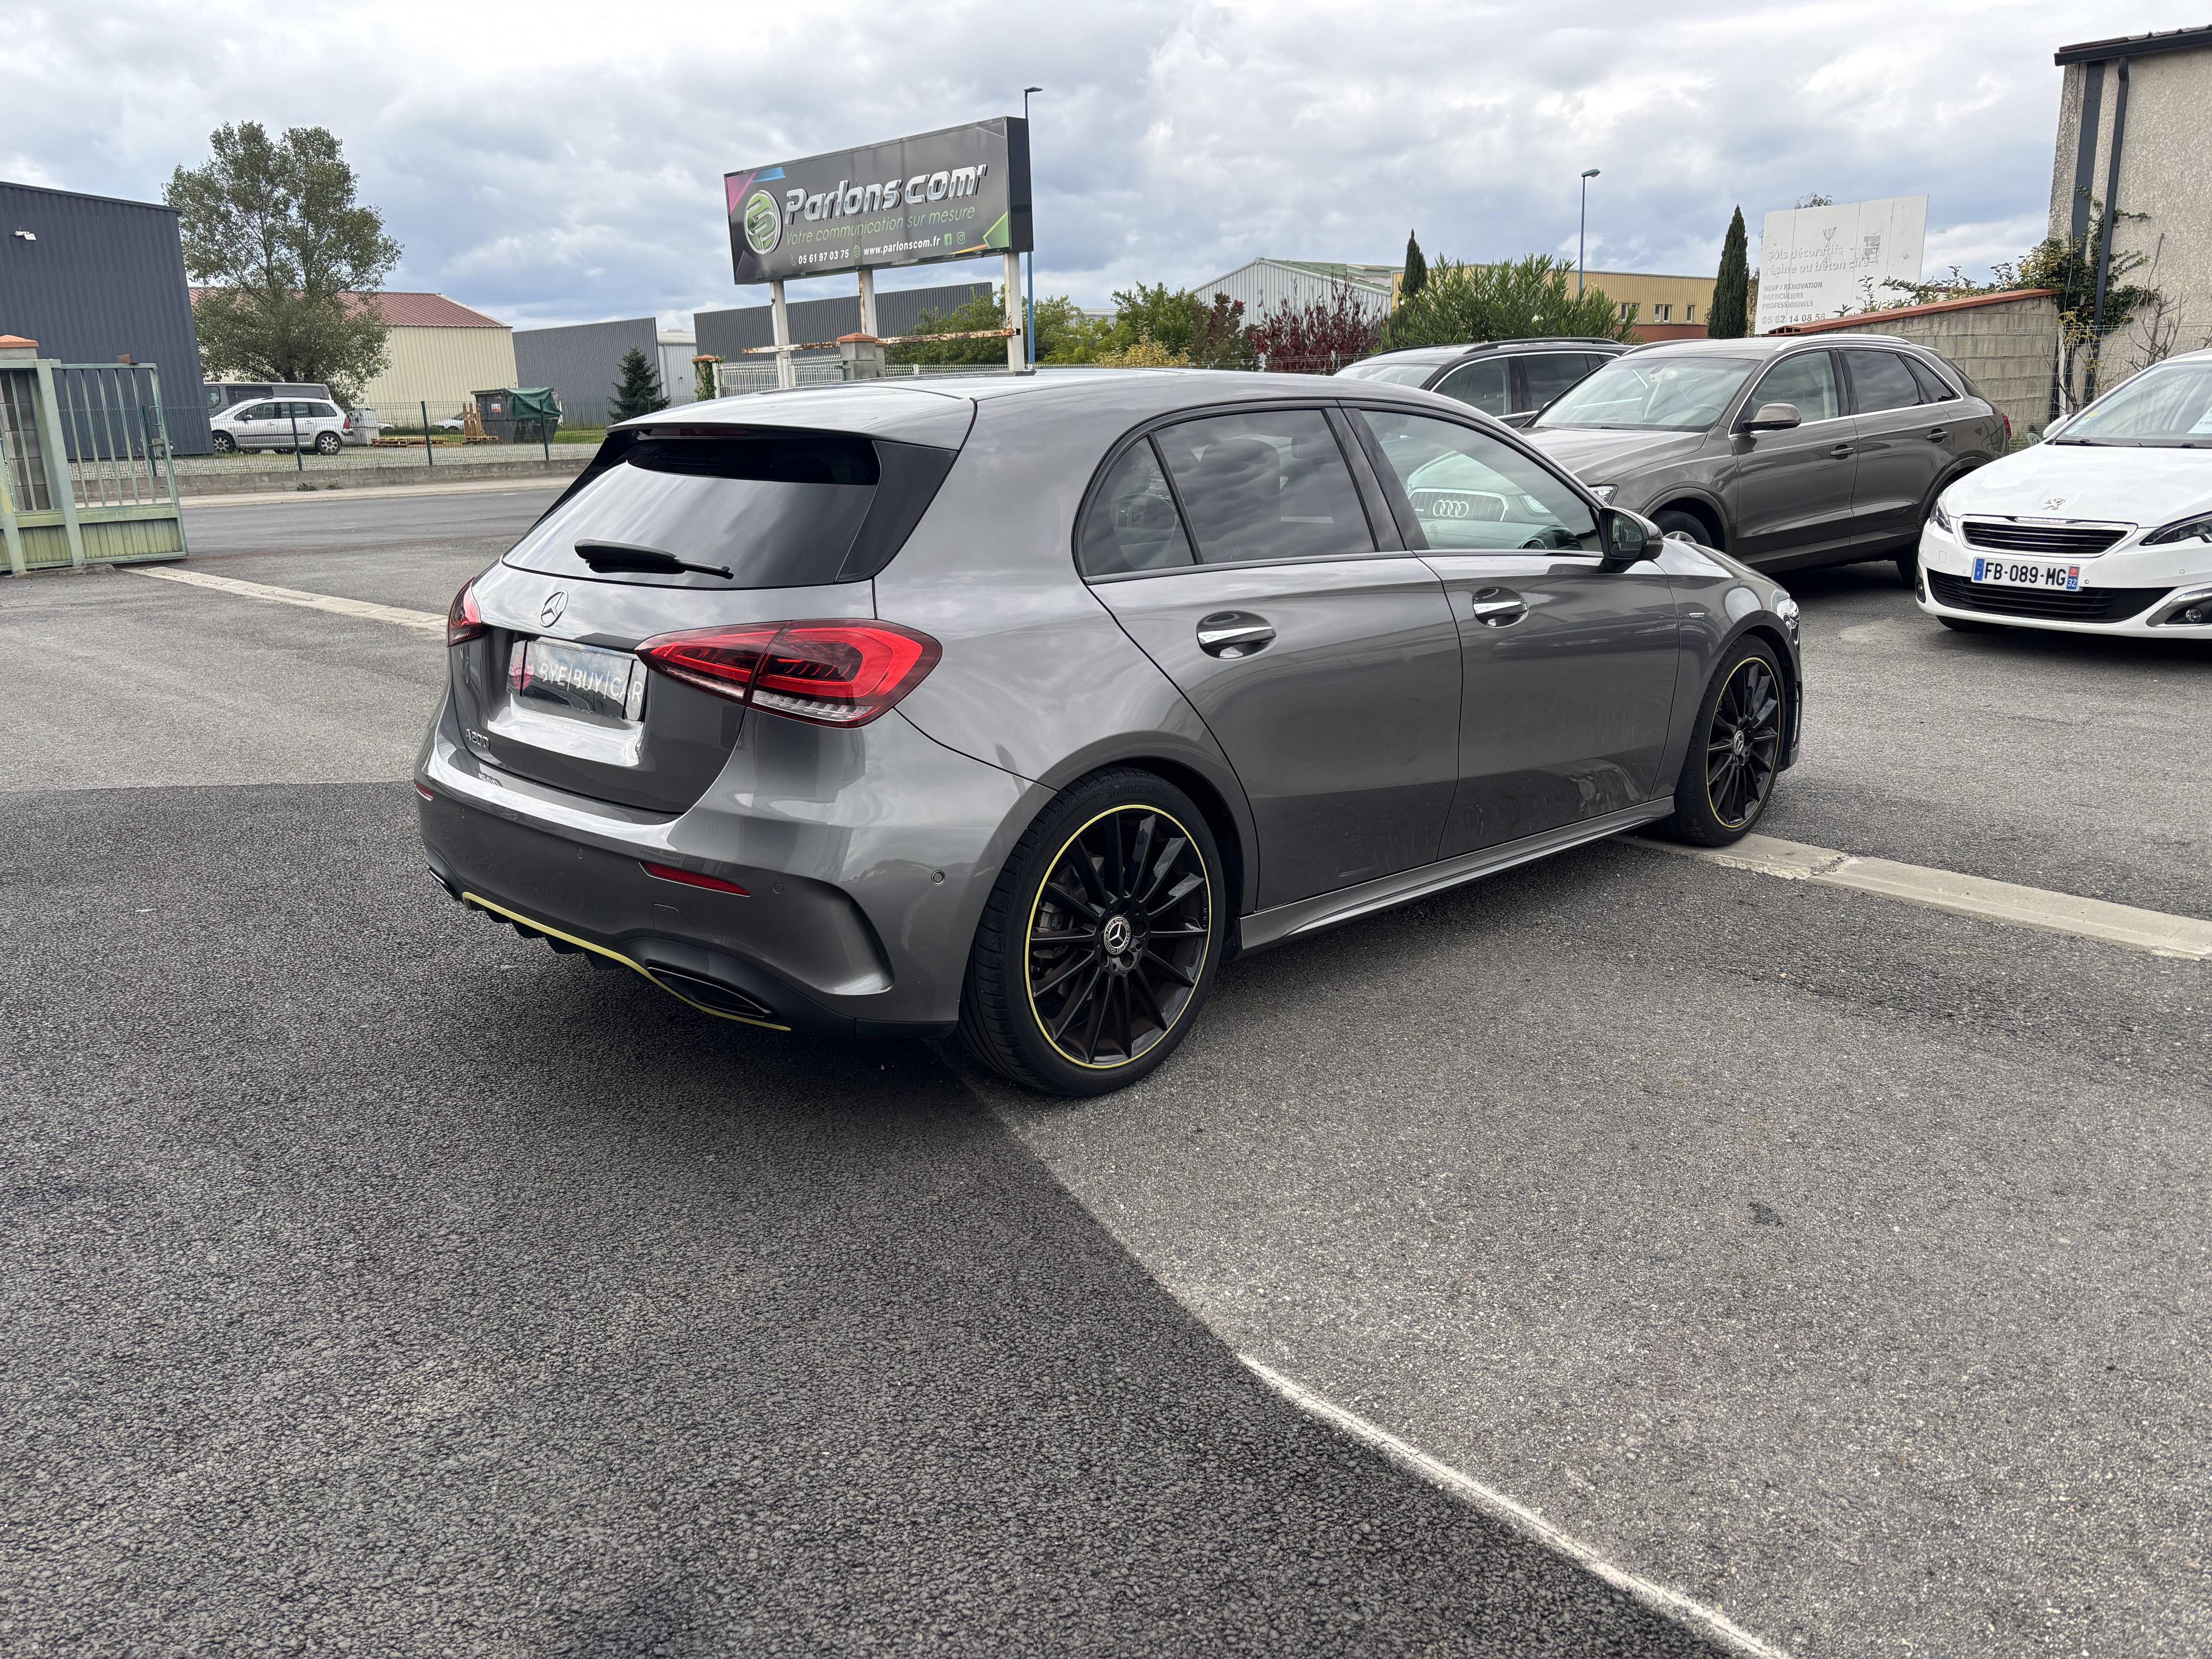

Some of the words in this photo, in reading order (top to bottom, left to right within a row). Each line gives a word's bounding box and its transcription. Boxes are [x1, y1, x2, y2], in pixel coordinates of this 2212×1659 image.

[785, 180, 902, 225] Parlons
[787, 230, 813, 246] Votre
[816, 217, 904, 242] communication
[907, 214, 926, 228] sur
[929, 206, 975, 225] mesure
[863, 236, 940, 255] www.parlonscom.fr
[798, 255, 807, 264] 05
[809, 253, 817, 263] 61
[819, 252, 828, 262] 97
[830, 251, 838, 260] 03
[840, 249, 849, 259] 75
[1800, 264, 1812, 273] ou
[1763, 292, 1804, 300] PARTICULIERS
[1762, 301, 1813, 309] PROFESSIONNELS
[1775, 315, 1785, 323] 62
[1789, 315, 1798, 323] 14
[1802, 314, 1812, 322] 08
[1815, 313, 1825, 321] 58
[1984, 562, 2066, 585] FB-089-MG
[2067, 578, 2077, 587] 32
